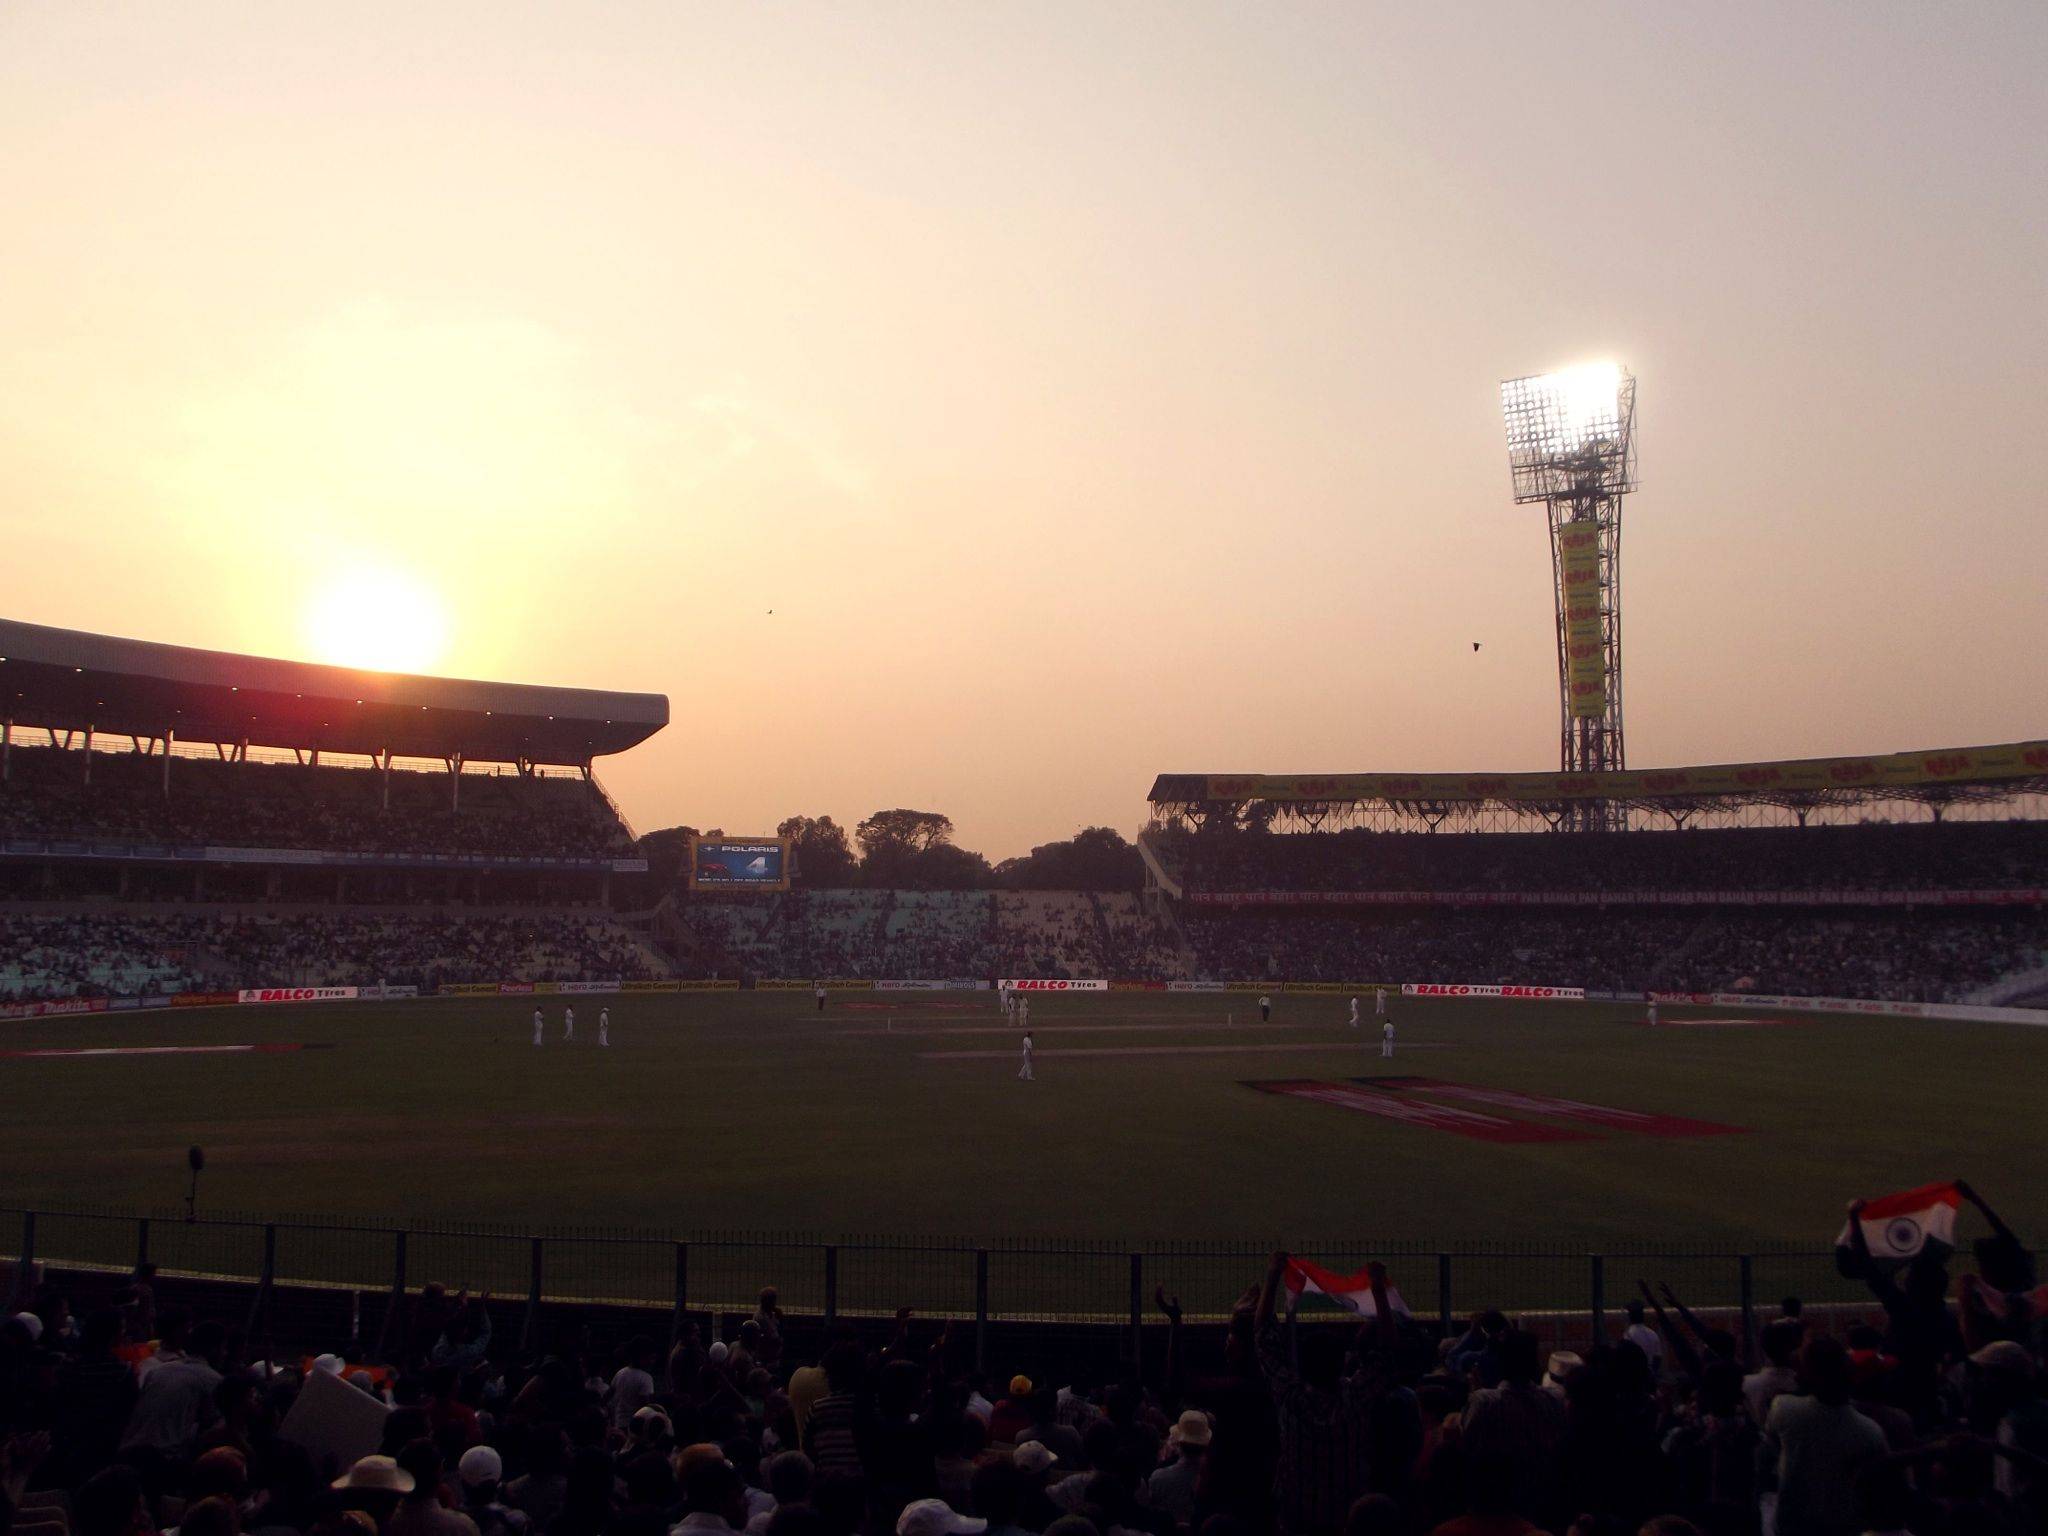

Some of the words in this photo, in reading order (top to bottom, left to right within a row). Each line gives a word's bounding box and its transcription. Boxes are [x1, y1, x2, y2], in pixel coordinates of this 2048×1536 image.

[722, 845, 778, 853] POLARIS
[1017, 980, 1068, 989] RALCO
[261, 989, 315, 1000] RALCO
[1417, 984, 1470, 995] RALCO
[1501, 986, 1553, 996] RALCO
